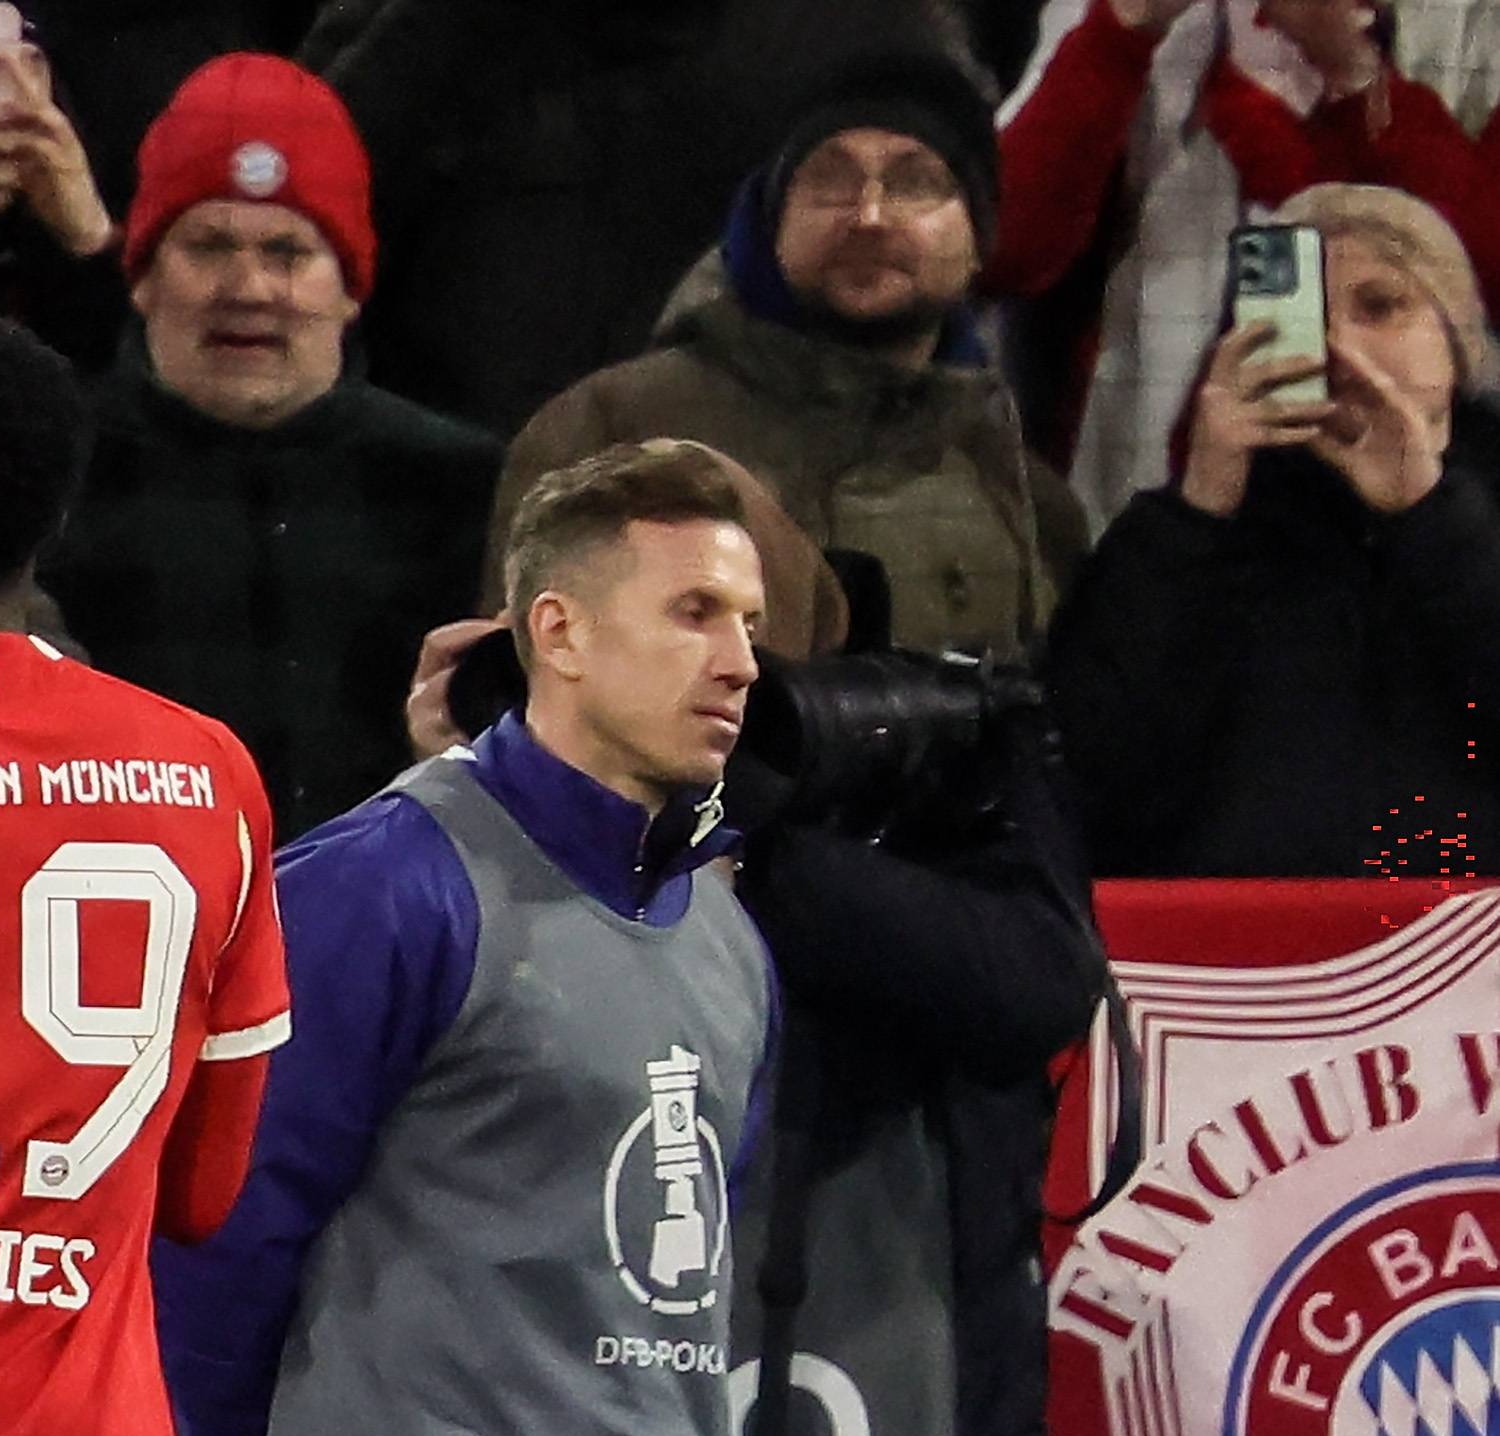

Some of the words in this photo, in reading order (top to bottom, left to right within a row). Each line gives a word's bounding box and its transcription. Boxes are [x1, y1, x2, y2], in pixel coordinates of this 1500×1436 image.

[38, 762, 216, 809] MÜNCHEN
[1058, 1042, 1421, 1342] FANCLUB
[1267, 1290, 1364, 1411] FC
